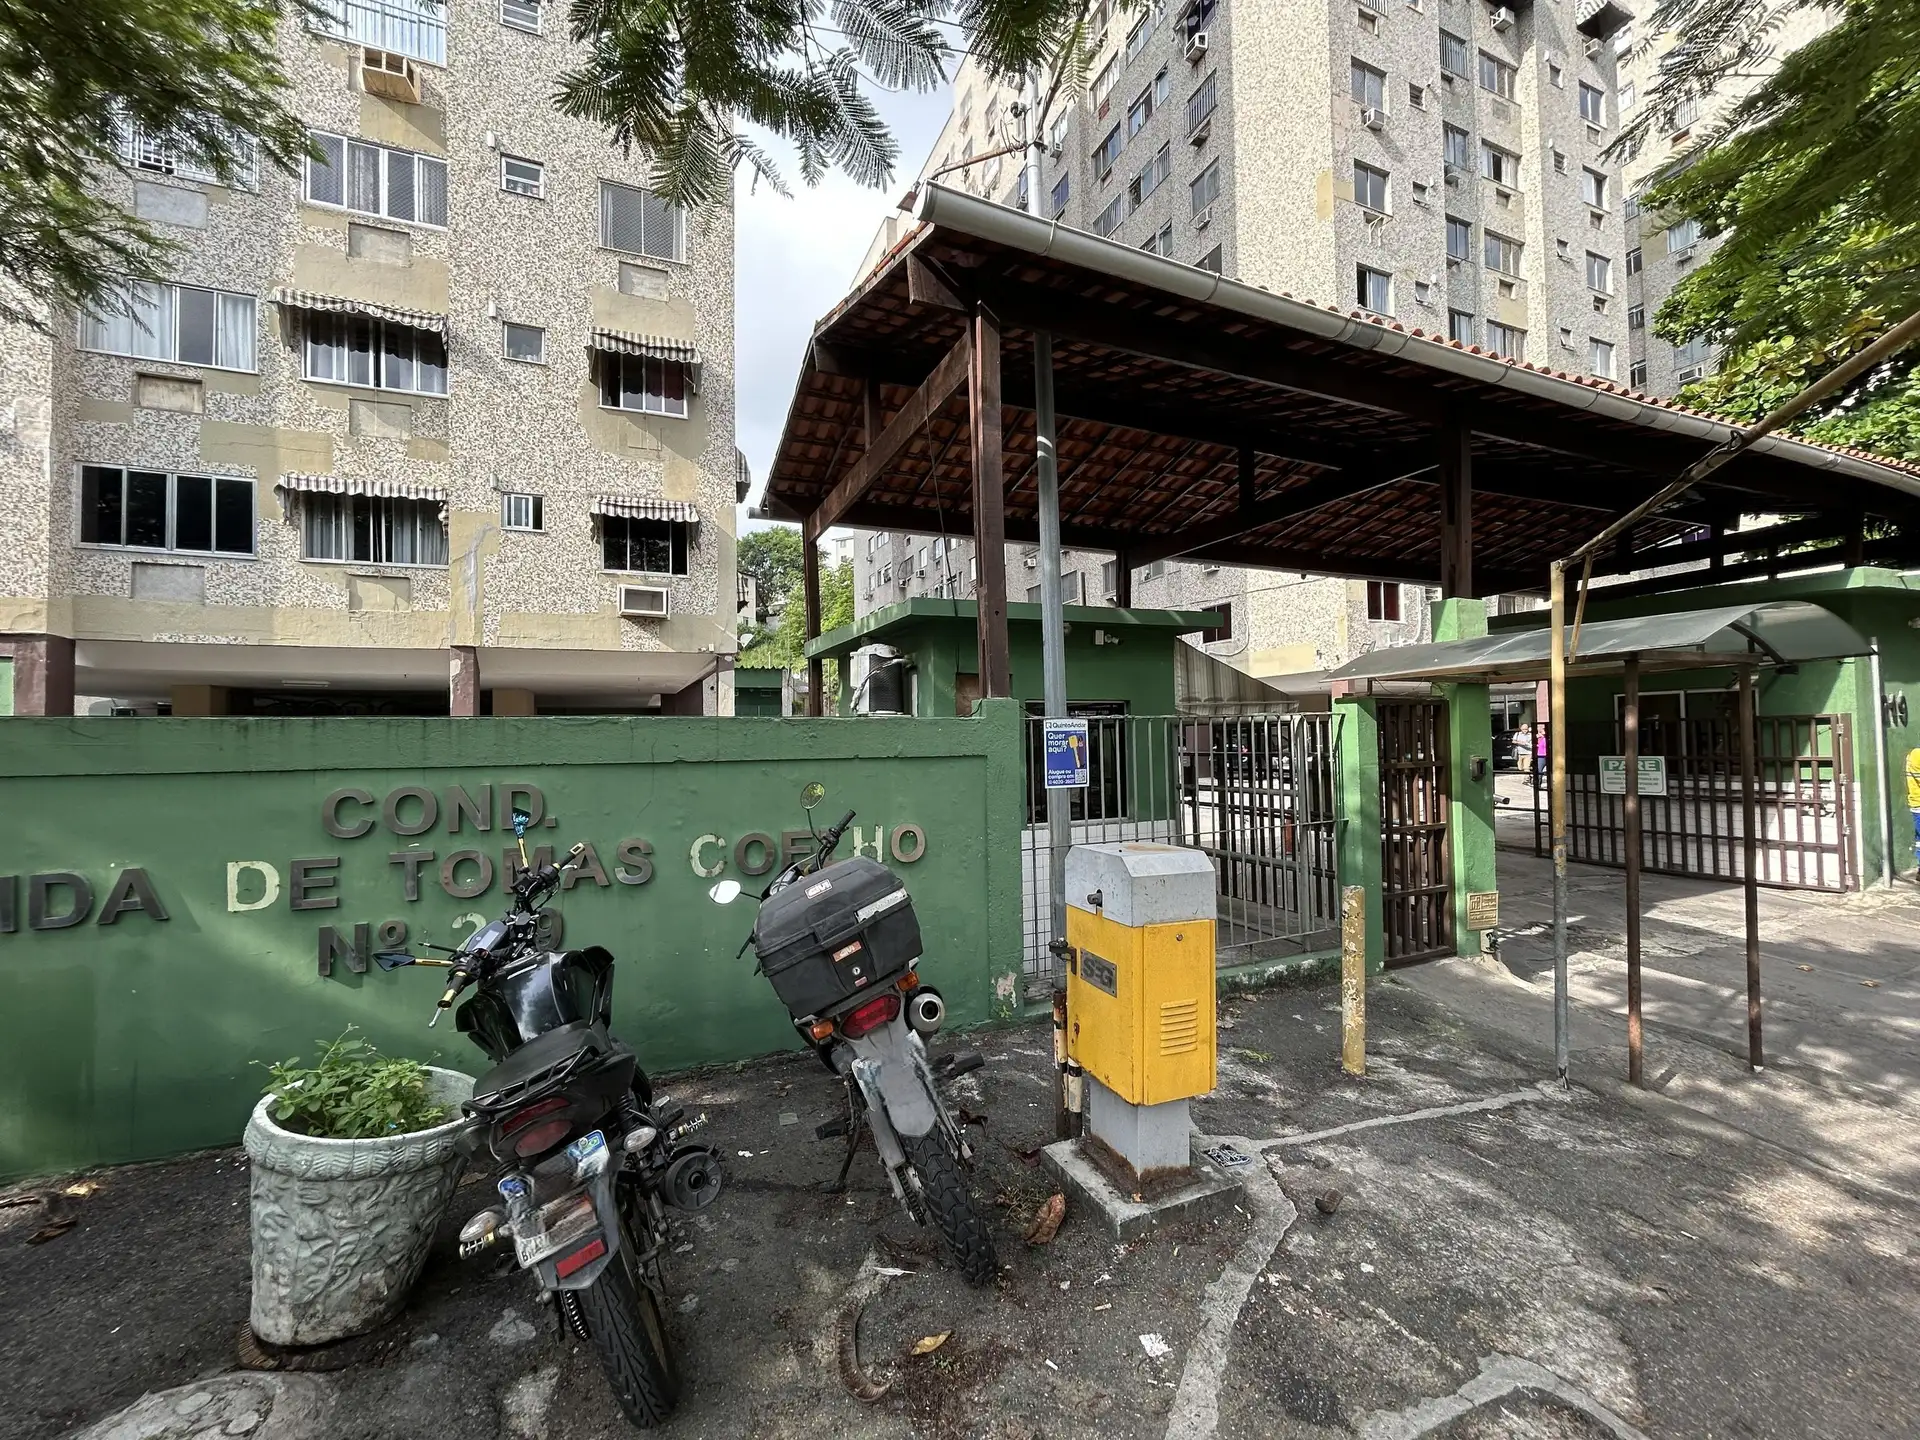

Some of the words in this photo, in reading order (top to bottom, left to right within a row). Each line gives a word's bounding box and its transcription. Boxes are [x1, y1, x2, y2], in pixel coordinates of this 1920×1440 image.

[1048, 746, 1067, 754] aqui?
[323, 784, 557, 838] COND.
[227, 857, 340, 911] DE
[389, 838, 653, 902] TOMAS
[690, 823, 927, 878] COEHO
